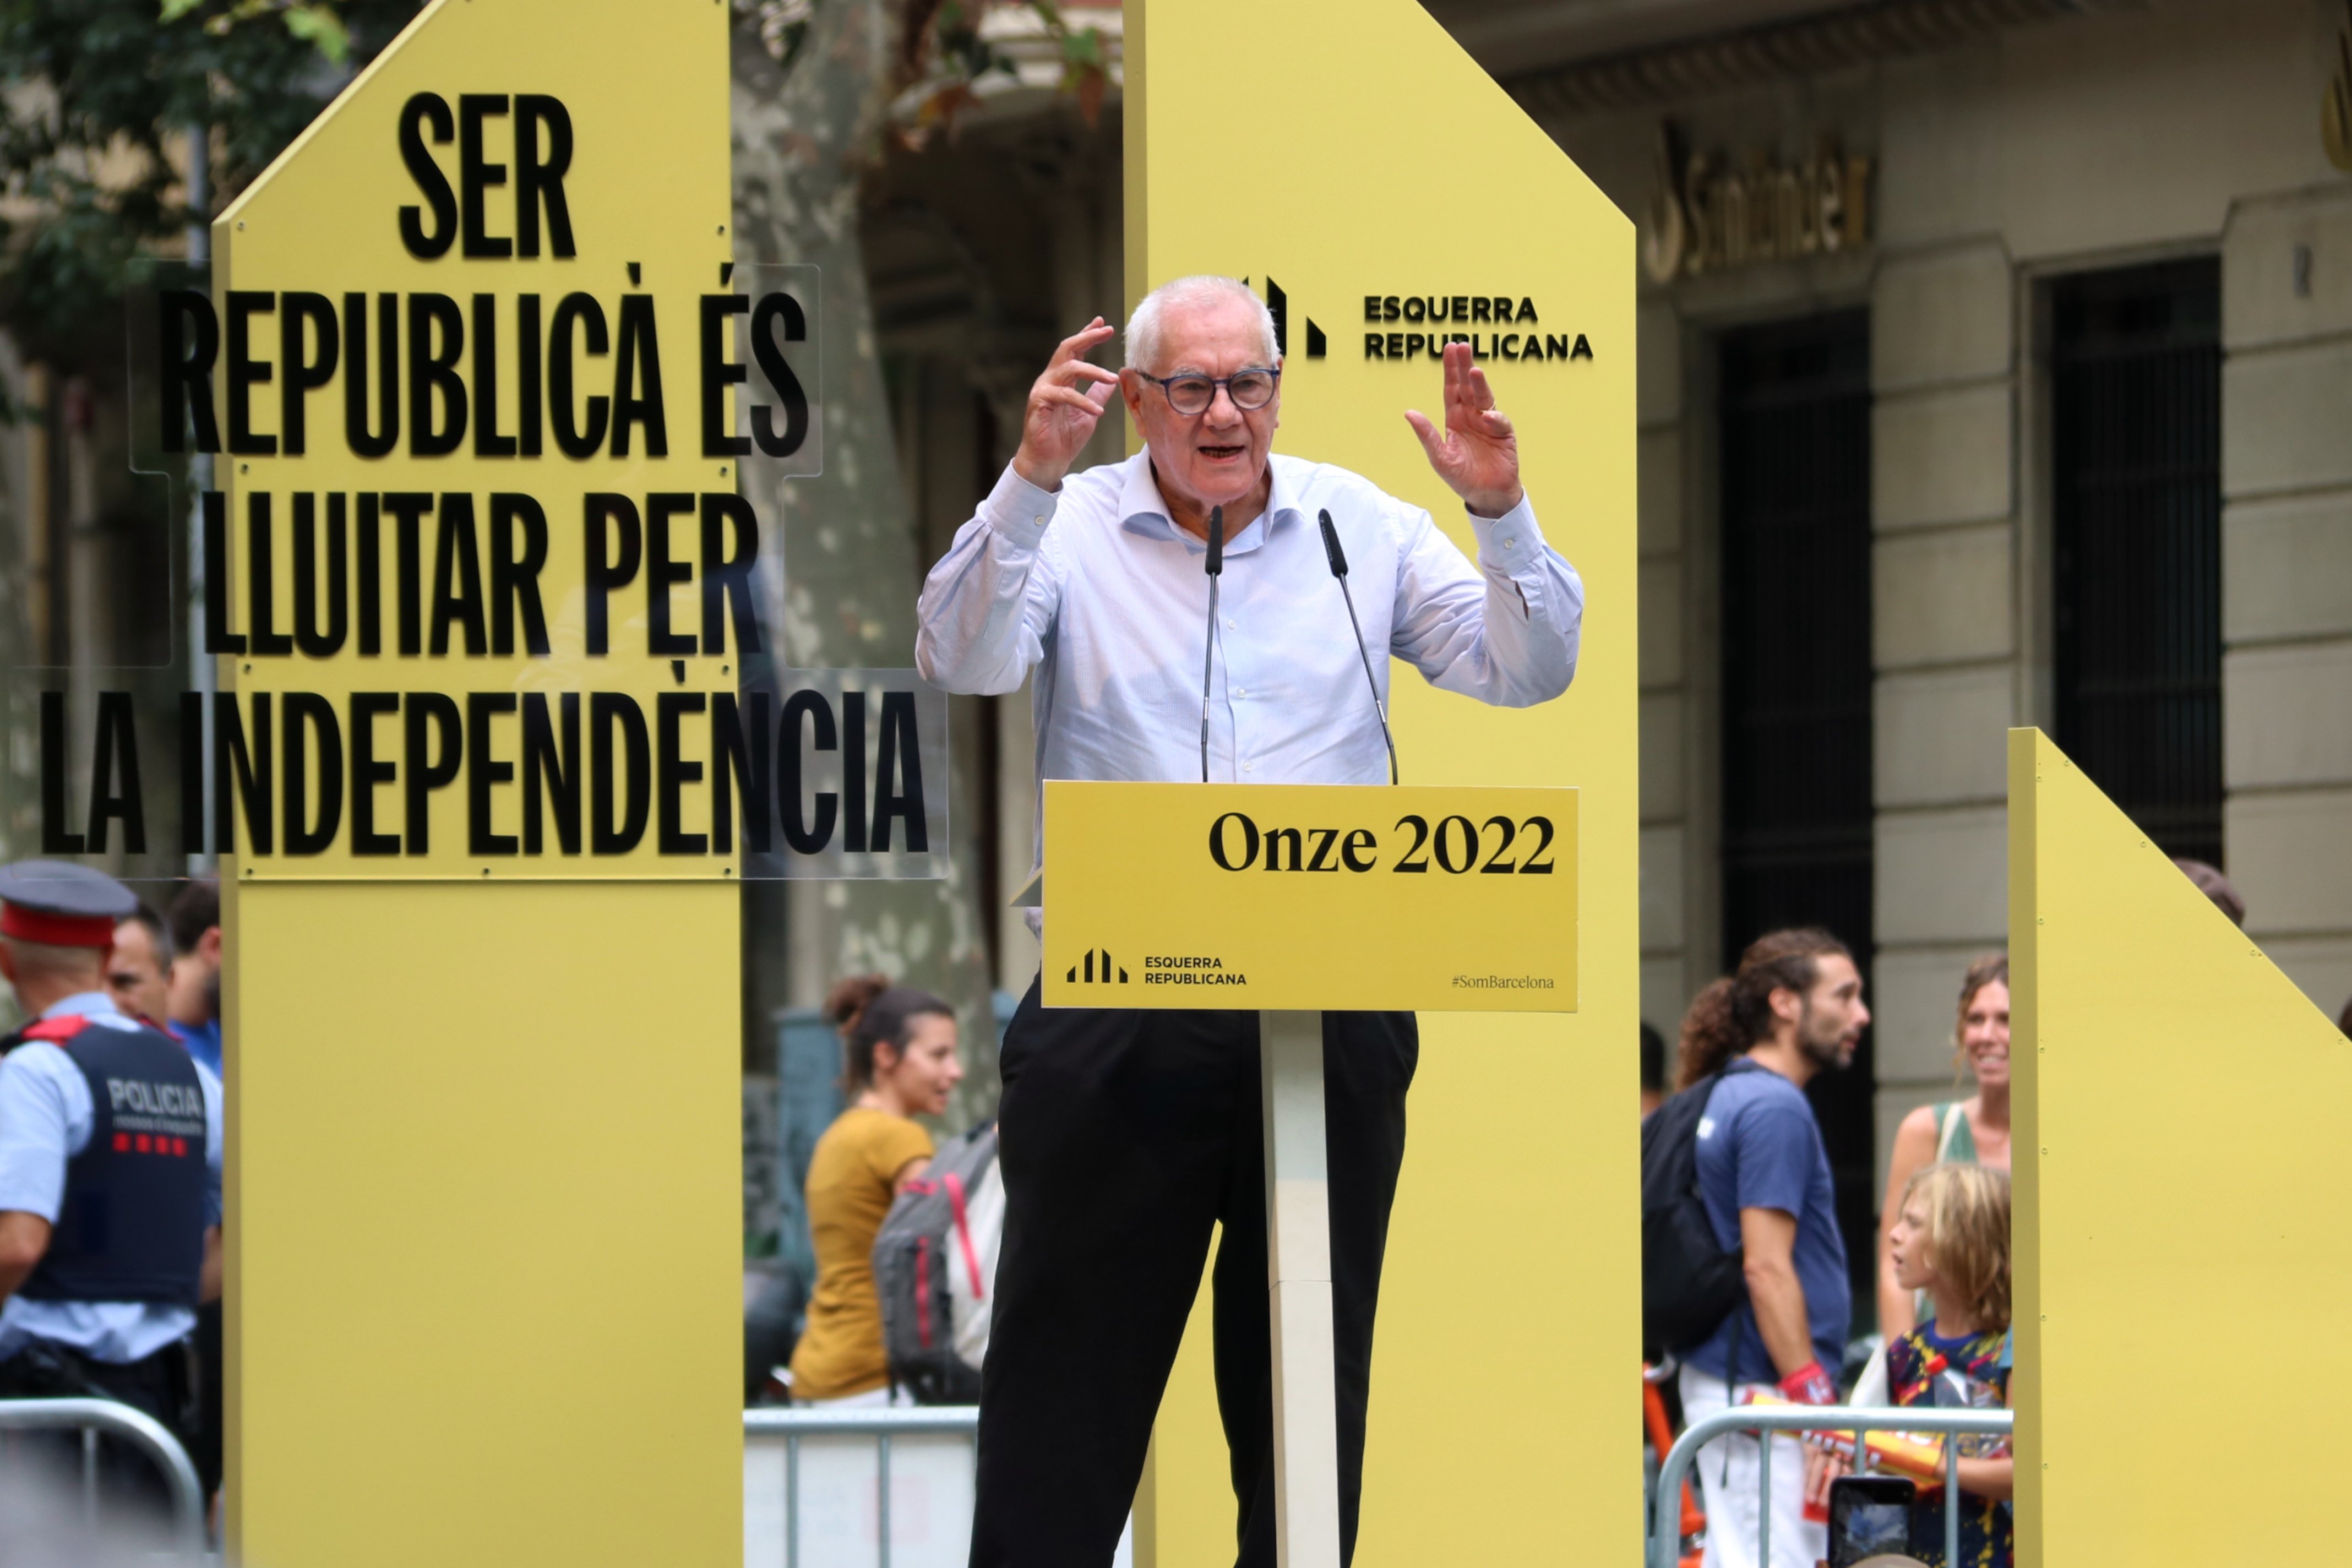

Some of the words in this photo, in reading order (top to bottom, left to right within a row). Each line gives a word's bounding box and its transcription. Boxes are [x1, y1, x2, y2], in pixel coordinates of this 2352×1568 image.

[398, 92, 576, 260] SER
[1364, 296, 1538, 325] ESQUERRA
[158, 262, 668, 459] REPUBLICÀ
[700, 262, 809, 459] ÉS
[202, 492, 550, 658] LLUITAR
[584, 492, 761, 656] PER
[40, 691, 146, 855] LA
[181, 660, 929, 856] INDEPENDÈNCIA
[1209, 812, 1378, 873] Onze
[1392, 815, 1555, 874] 2022
[1145, 956, 1223, 969] ESQUERRA
[1145, 973, 1247, 986] REPUBLICANA
[1452, 975, 1554, 989] #SomBarcelona
[107, 1079, 202, 1118] POLICIA
